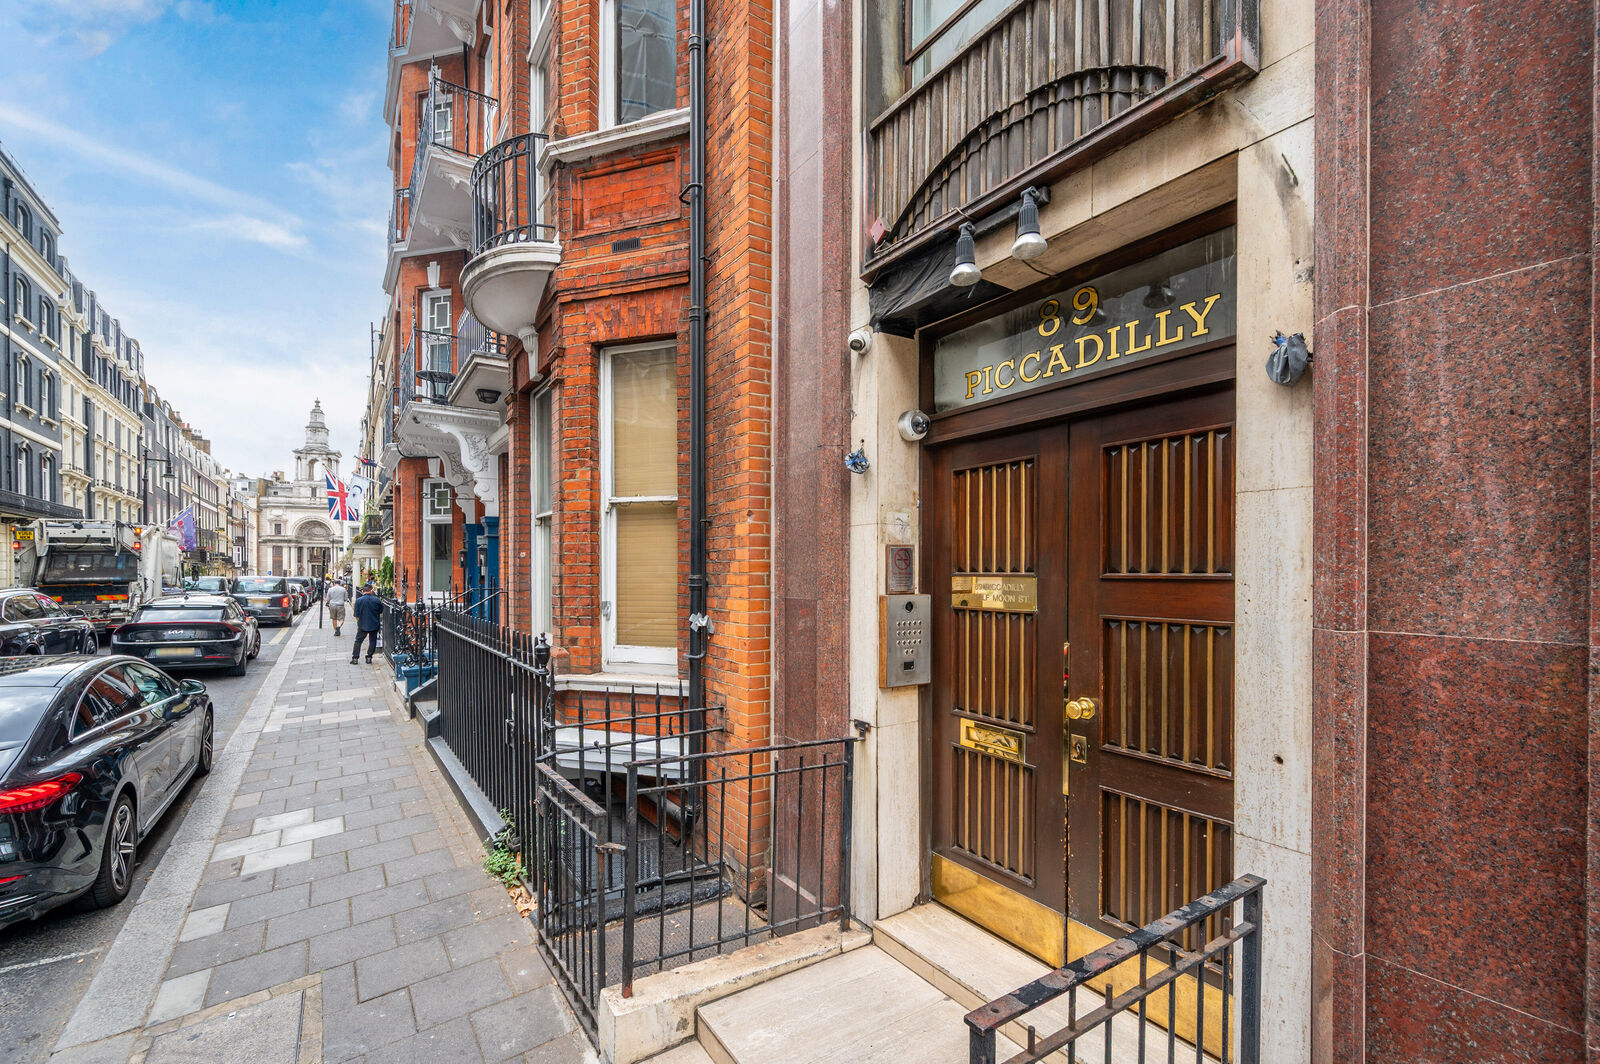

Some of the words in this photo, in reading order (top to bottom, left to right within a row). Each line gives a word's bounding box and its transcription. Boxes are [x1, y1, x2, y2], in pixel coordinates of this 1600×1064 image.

[1037, 285, 1100, 338] 89
[963, 292, 1222, 400] PICCADILLY
[992, 593, 1016, 603] MOON
